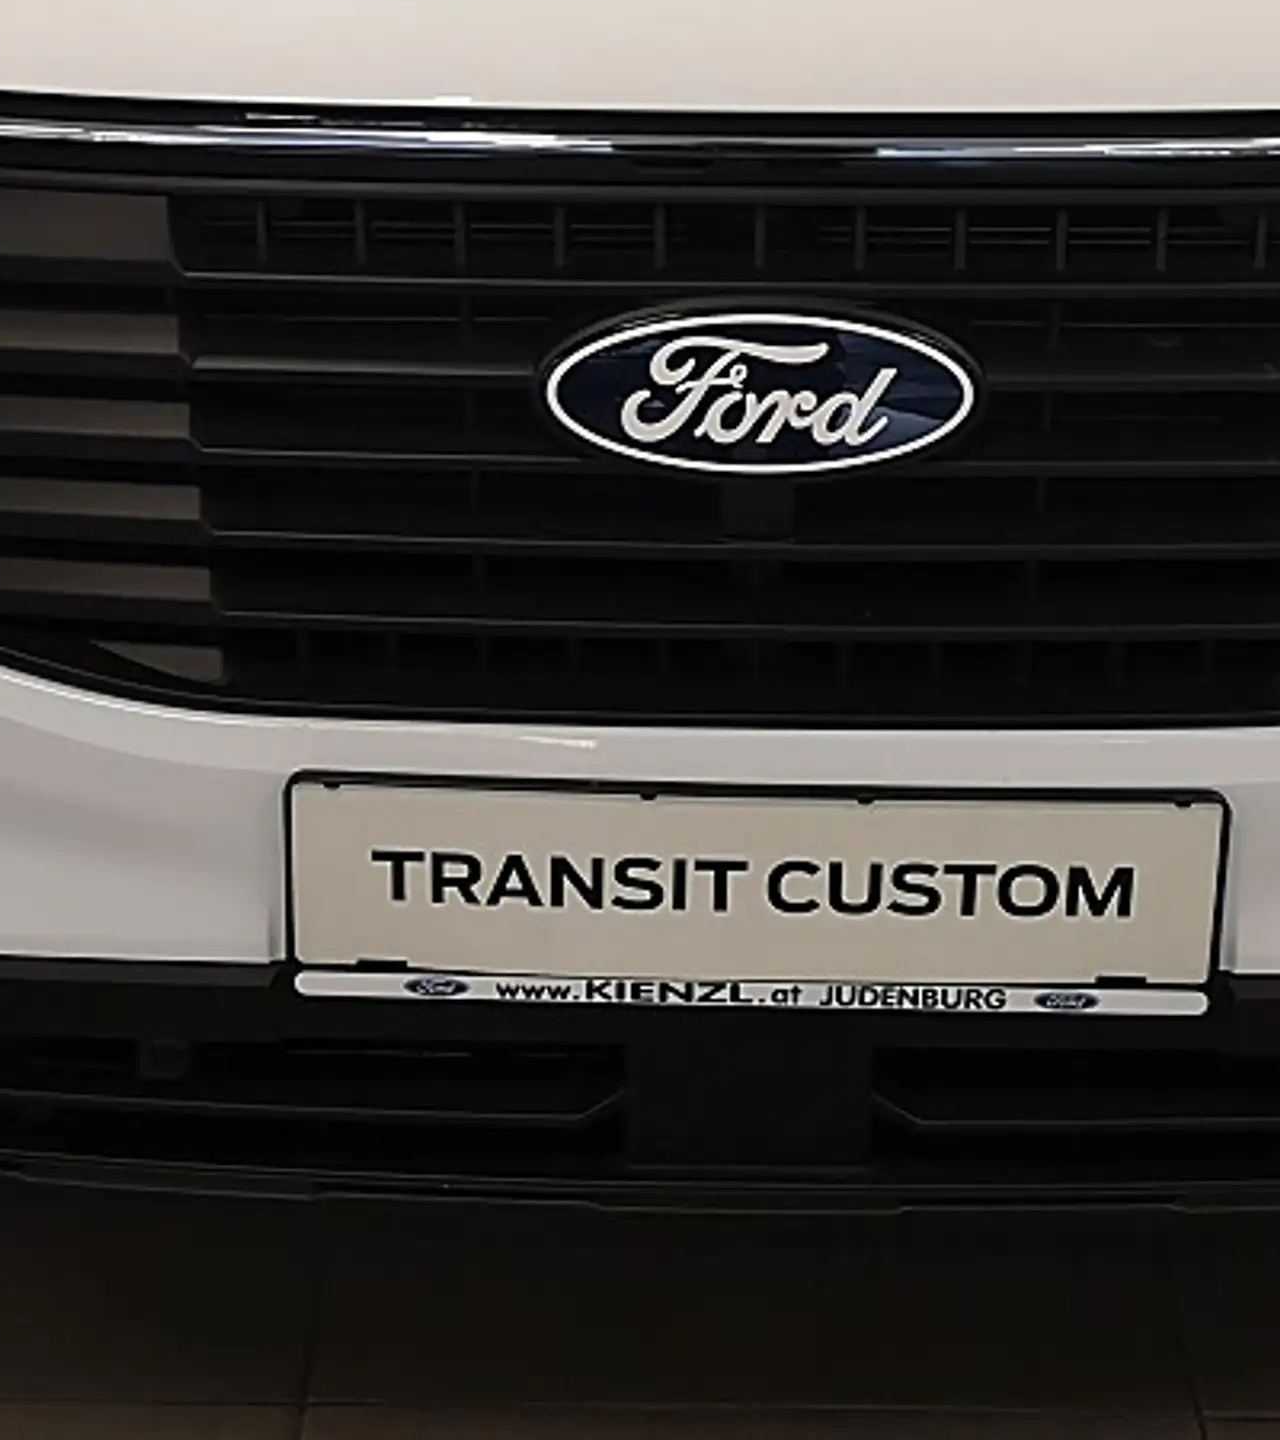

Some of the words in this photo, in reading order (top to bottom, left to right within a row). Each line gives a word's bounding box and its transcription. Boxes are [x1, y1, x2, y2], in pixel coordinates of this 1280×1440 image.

[620, 335, 898, 446] Ford
[371, 848, 749, 913] TRANSIT
[766, 860, 1136, 917] CUSTOM
[496, 980, 803, 1006] www.KIENZL.at
[819, 985, 1007, 1010] JUDENBURG
